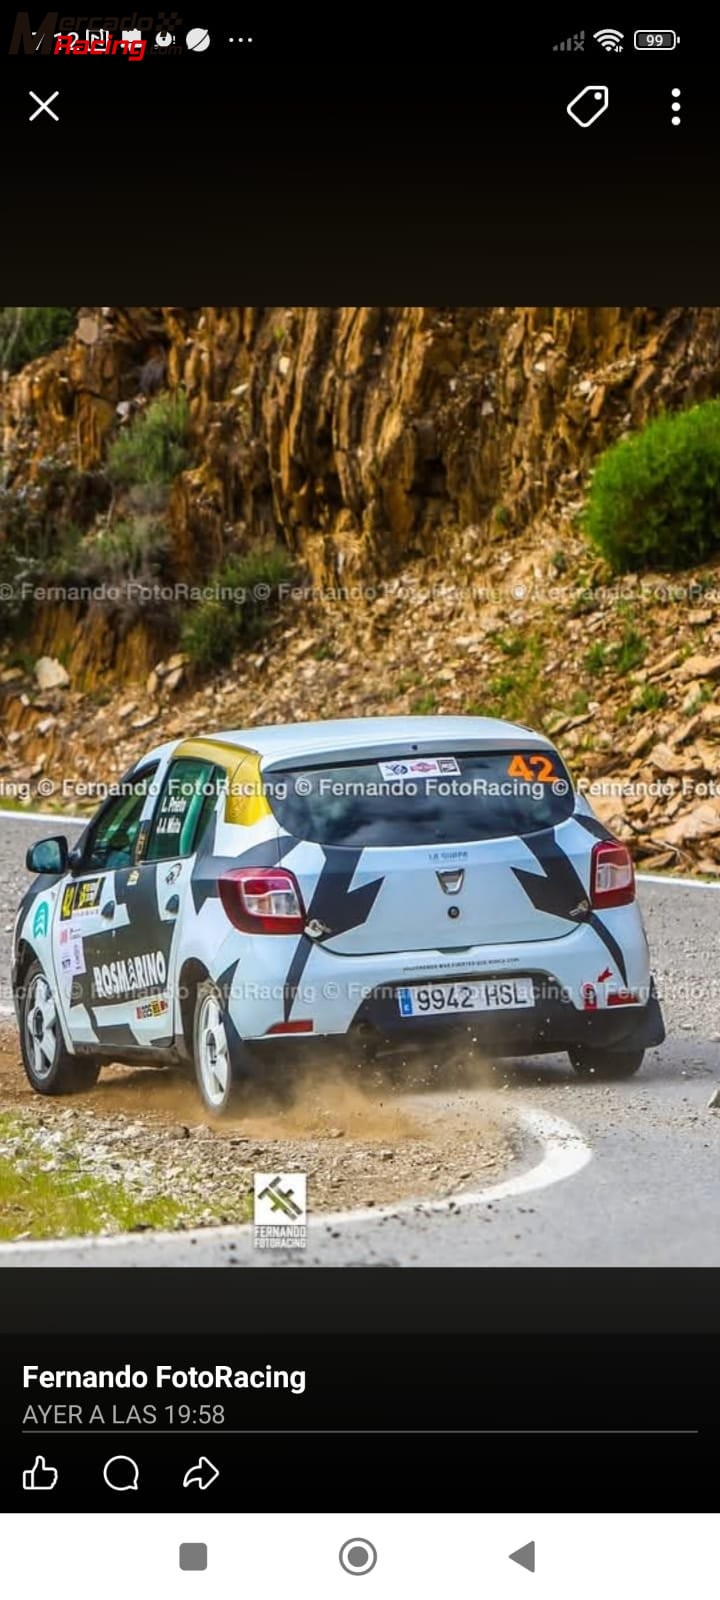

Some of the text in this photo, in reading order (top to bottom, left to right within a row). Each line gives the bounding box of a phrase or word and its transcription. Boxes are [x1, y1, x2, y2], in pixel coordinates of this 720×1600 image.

[646, 34, 664, 47] 99
[507, 754, 559, 782] 42
[417, 983, 528, 1011] 9942 HSL
[22, 1364, 306, 1394] Fernando FotoRacing
[22, 1404, 225, 1425] AYER A LAS 19:58
